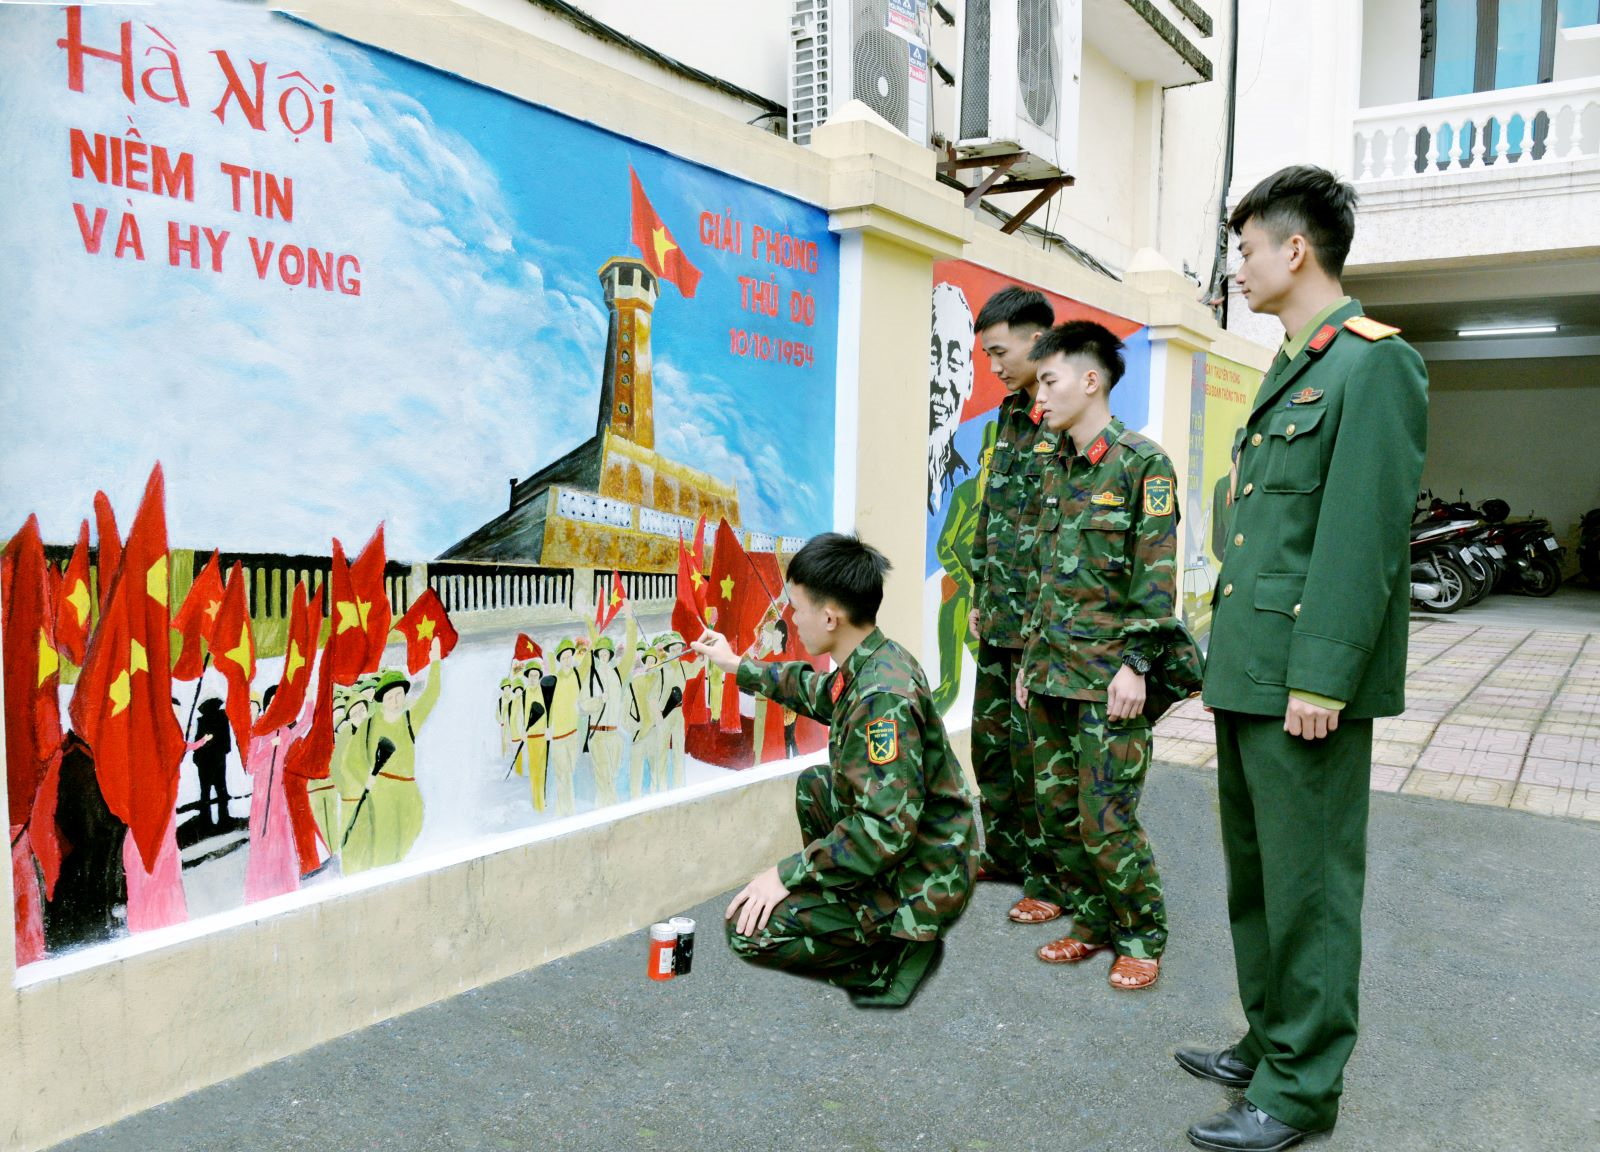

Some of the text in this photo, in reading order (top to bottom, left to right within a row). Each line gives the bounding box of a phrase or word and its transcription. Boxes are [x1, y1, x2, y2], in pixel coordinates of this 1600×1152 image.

[56, 5, 336, 143] Hà Nội
[70, 115, 293, 223] NIỀM TIN
[72, 198, 361, 297] VÀ HY VỌNG
[729, 327, 815, 368] 10/10/1954
